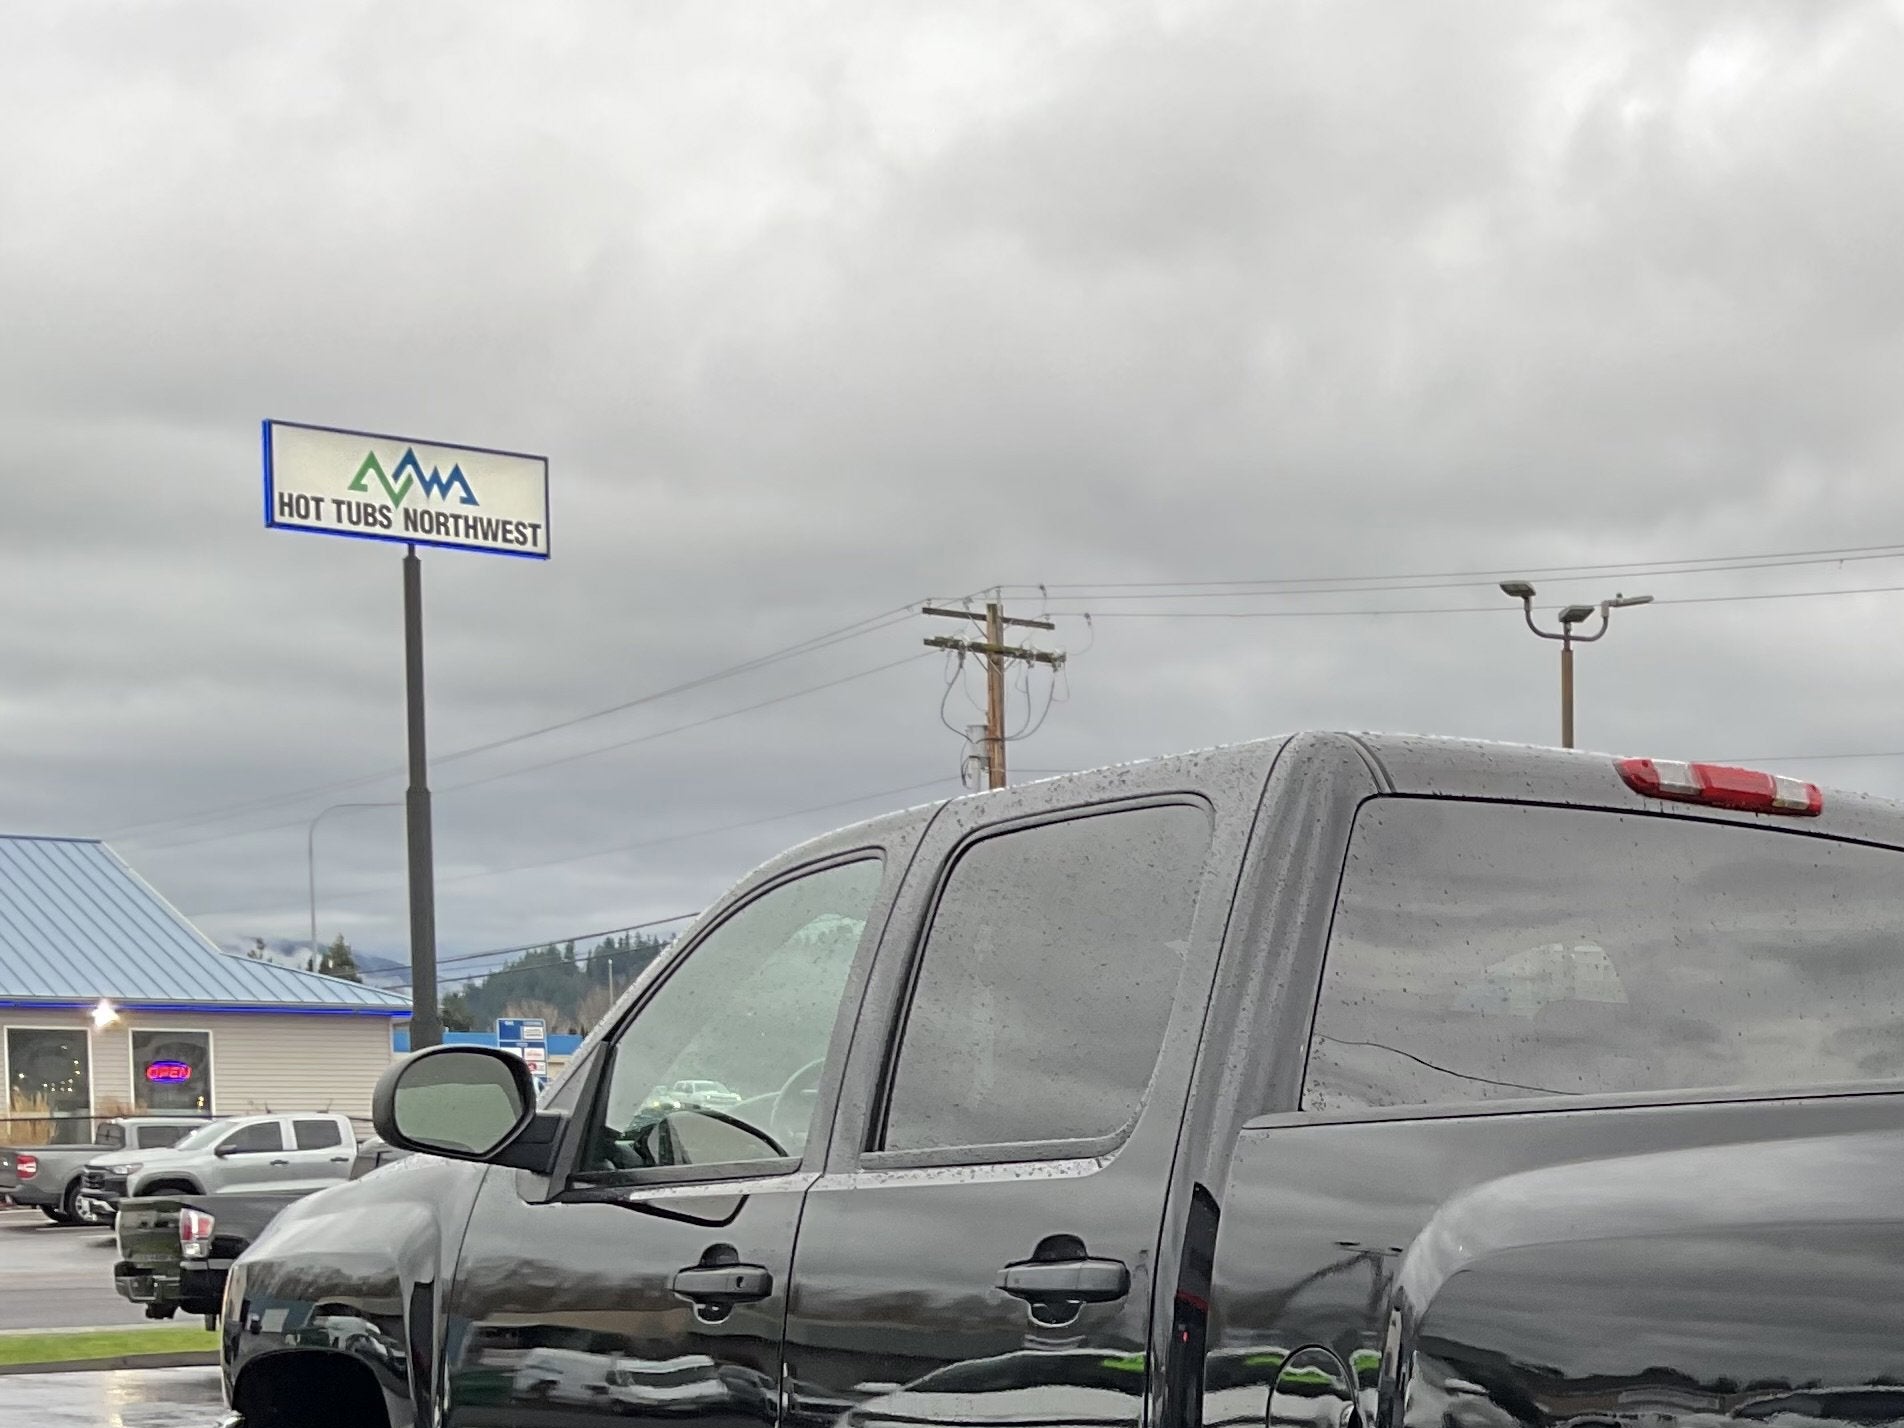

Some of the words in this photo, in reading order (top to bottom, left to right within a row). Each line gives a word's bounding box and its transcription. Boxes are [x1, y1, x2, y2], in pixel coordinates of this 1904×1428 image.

[278, 491, 325, 521] HOT
[331, 498, 393, 530] TUBS
[403, 507, 542, 547] NORTHWEST
[146, 1065, 192, 1079] OPEN
